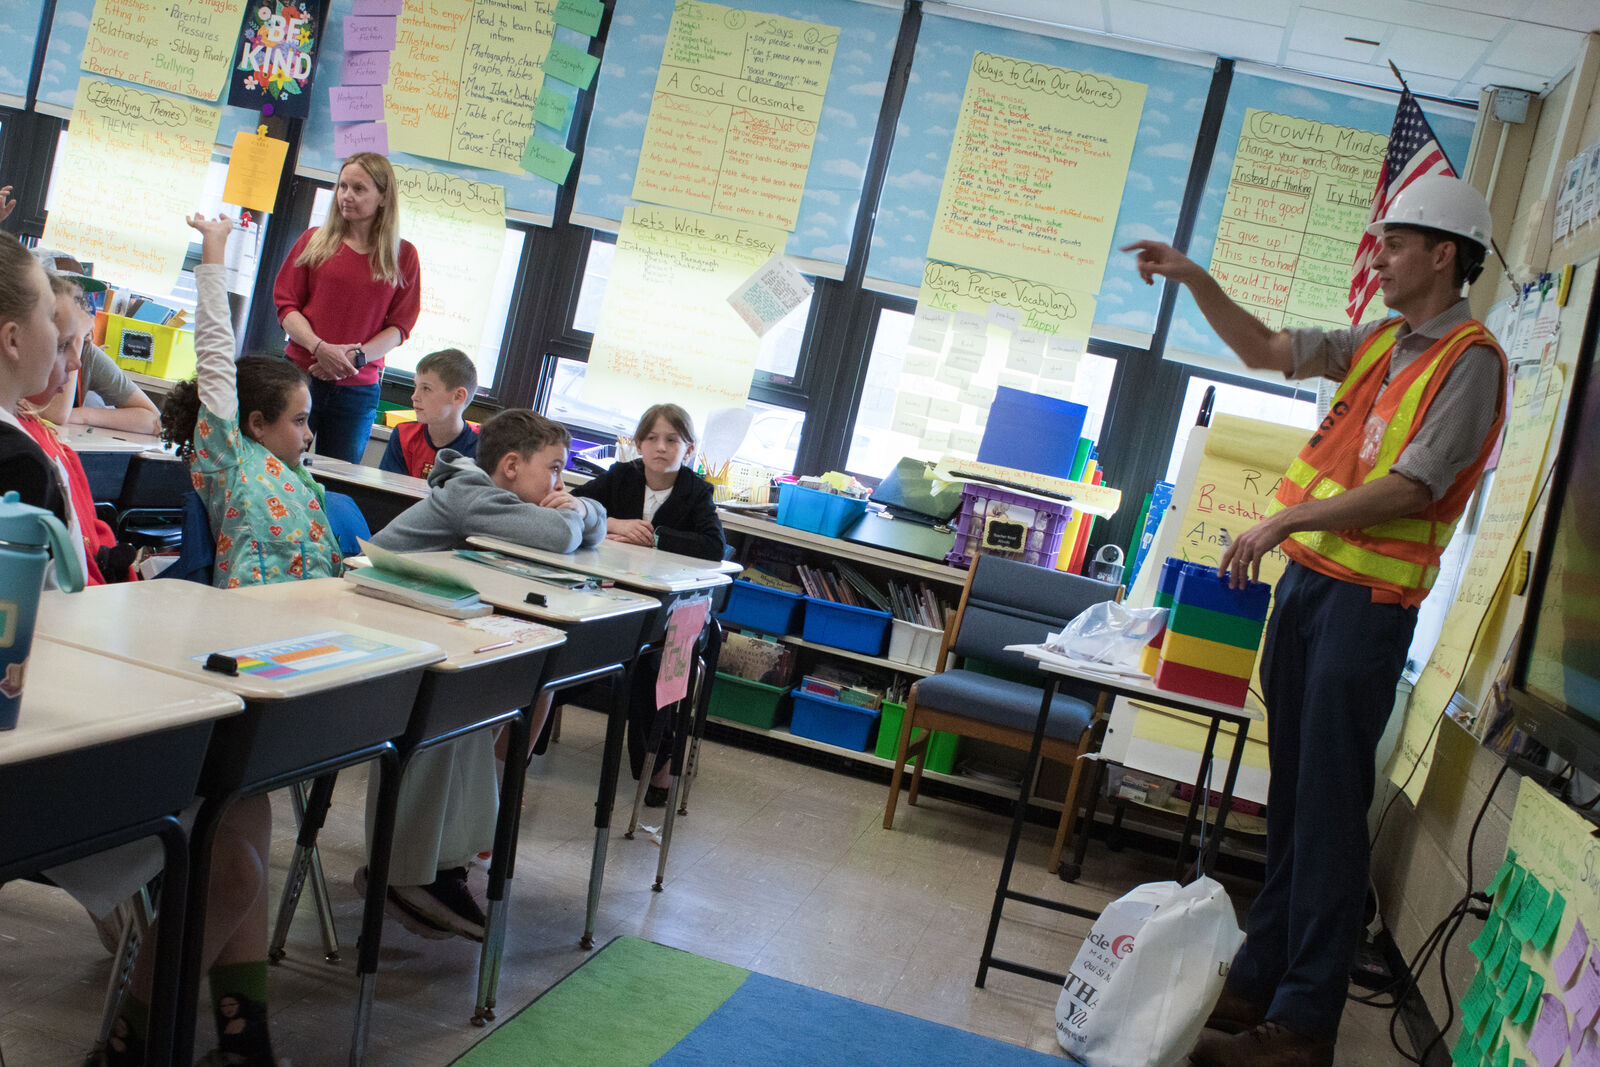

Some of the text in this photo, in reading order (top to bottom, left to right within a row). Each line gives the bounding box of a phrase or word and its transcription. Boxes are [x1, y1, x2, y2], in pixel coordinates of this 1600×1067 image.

[170, 4, 212, 26] Parental
[476, 10, 533, 33] Read to learn
[96, 17, 159, 48] Relationships
[177, 20, 220, 42] Pressures
[268, 14, 303, 46] BE
[490, 27, 515, 44] inform
[765, 18, 794, 39] Says
[92, 38, 129, 60] Divorce
[171, 39, 230, 69] Sibling Rivalry
[408, 46, 441, 63] Pictures
[156, 53, 195, 83] Bullying
[241, 42, 311, 80] KIND
[128, 73, 138, 82] or
[143, 71, 182, 92] Financial
[506, 66, 533, 81] tables
[977, 60, 1113, 100] Ways to Calm Our Worries
[465, 77, 508, 98] Main Idea
[667, 72, 805, 113] A Good Classmate
[94, 90, 181, 121] Identifying Themes
[466, 103, 487, 120] Table
[974, 101, 1031, 120] Read book
[100, 115, 139, 137] THEME
[973, 109, 989, 119] Play
[1004, 118, 1022, 128] sport
[1038, 124, 1051, 132] get
[457, 137, 484, 154] Cause
[492, 129, 526, 150] Contrast
[1260, 112, 1388, 157] Growth Mindse
[966, 136, 1078, 168] Think about something happy
[1238, 138, 1274, 159] Change
[1279, 150, 1299, 165] your
[1331, 156, 1360, 178] Change
[1233, 165, 1268, 185] Instead
[1271, 173, 1282, 189] of
[1020, 185, 1043, 195] shower
[1023, 194, 1036, 202] rest
[1326, 183, 1375, 206] Try think
[1234, 206, 1248, 219] at
[1257, 195, 1306, 217] not good
[950, 212, 969, 222] Think
[973, 218, 992, 228] about
[632, 208, 776, 257] Let's Write an Essay
[1239, 231, 1260, 246] give
[621, 240, 719, 268] Introduction Paragraph
[1249, 255, 1257, 264] is
[1262, 253, 1275, 269] too
[928, 267, 1071, 315] Using Precise Vocabulary
[1233, 272, 1259, 288] could
[1262, 275, 1271, 290] I
[929, 293, 957, 311] Nice
[1242, 291, 1249, 300] a
[1024, 312, 1060, 335] Happy
[1087, 929, 1110, 950] cle
[1089, 949, 1117, 968] MARK
[1064, 971, 1100, 1011] THA
